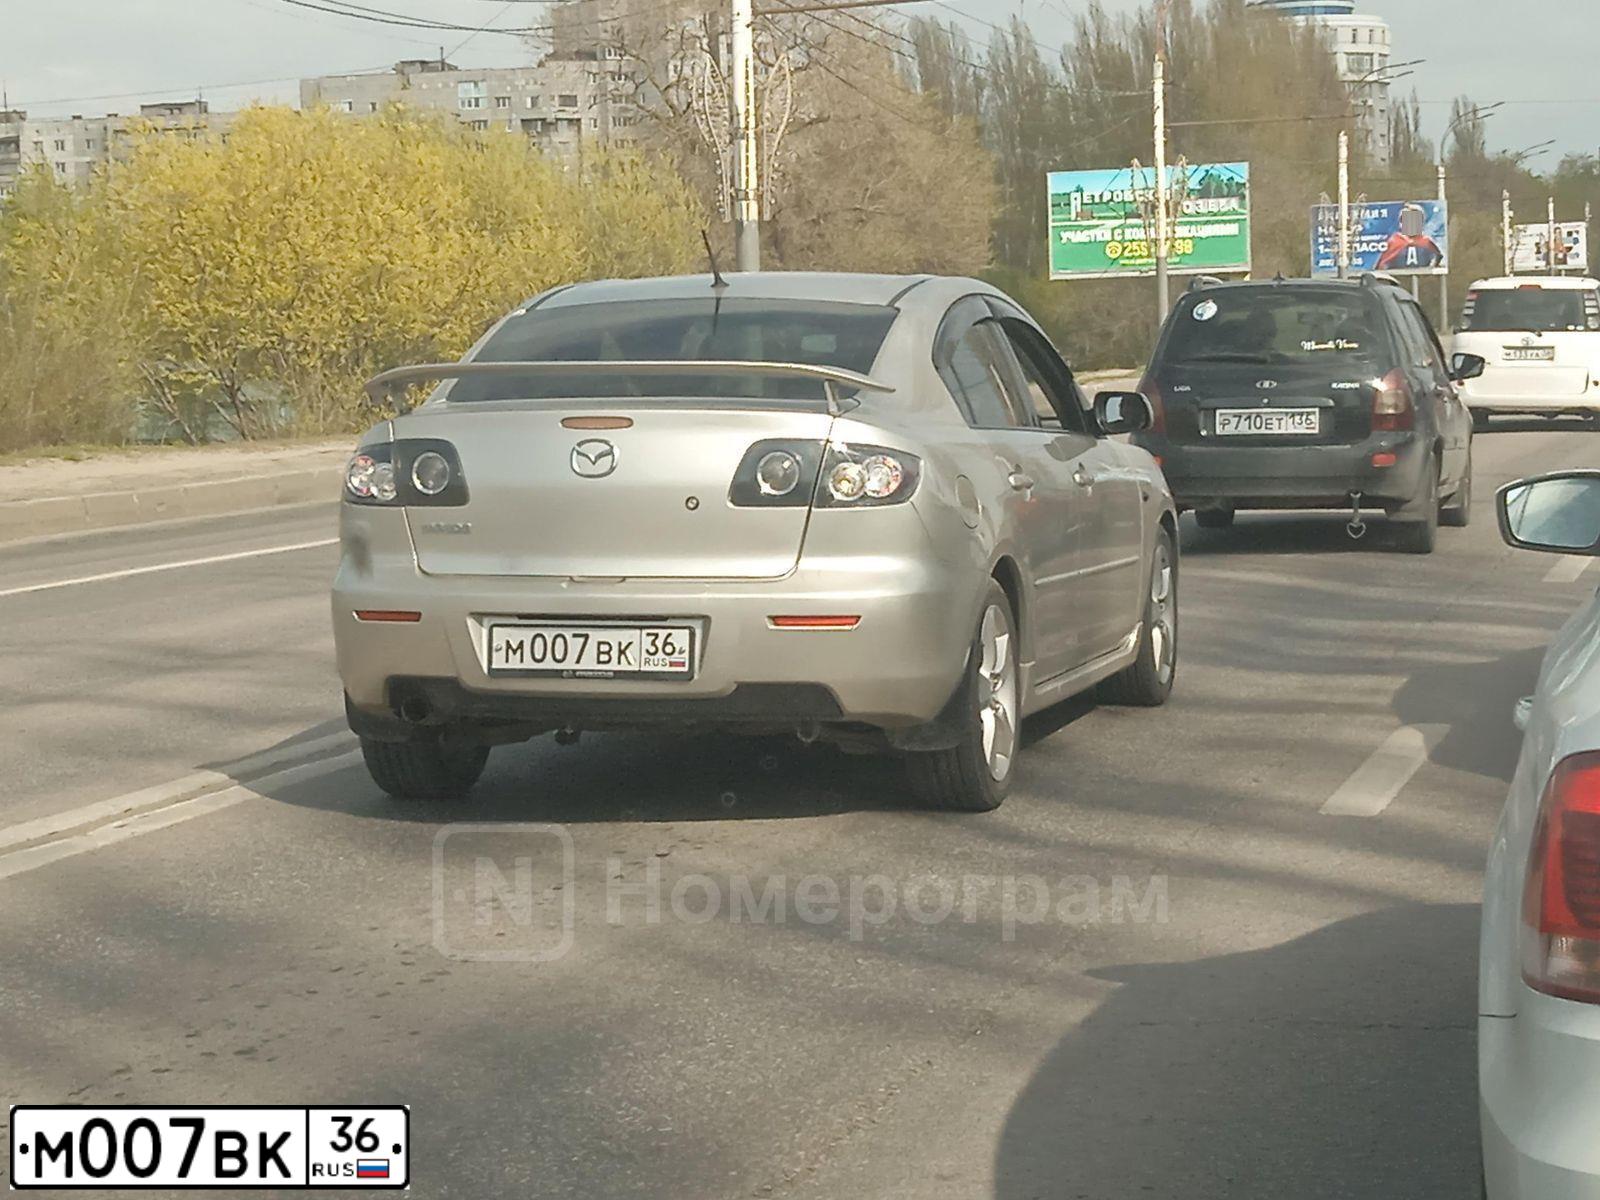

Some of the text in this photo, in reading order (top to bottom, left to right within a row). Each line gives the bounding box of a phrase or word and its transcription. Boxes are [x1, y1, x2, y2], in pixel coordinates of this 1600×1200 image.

[1220, 412, 1314, 431] Р710ЕТ 136
[504, 632, 677, 666] М007ВК 36
[643, 657, 668, 667] RUS
